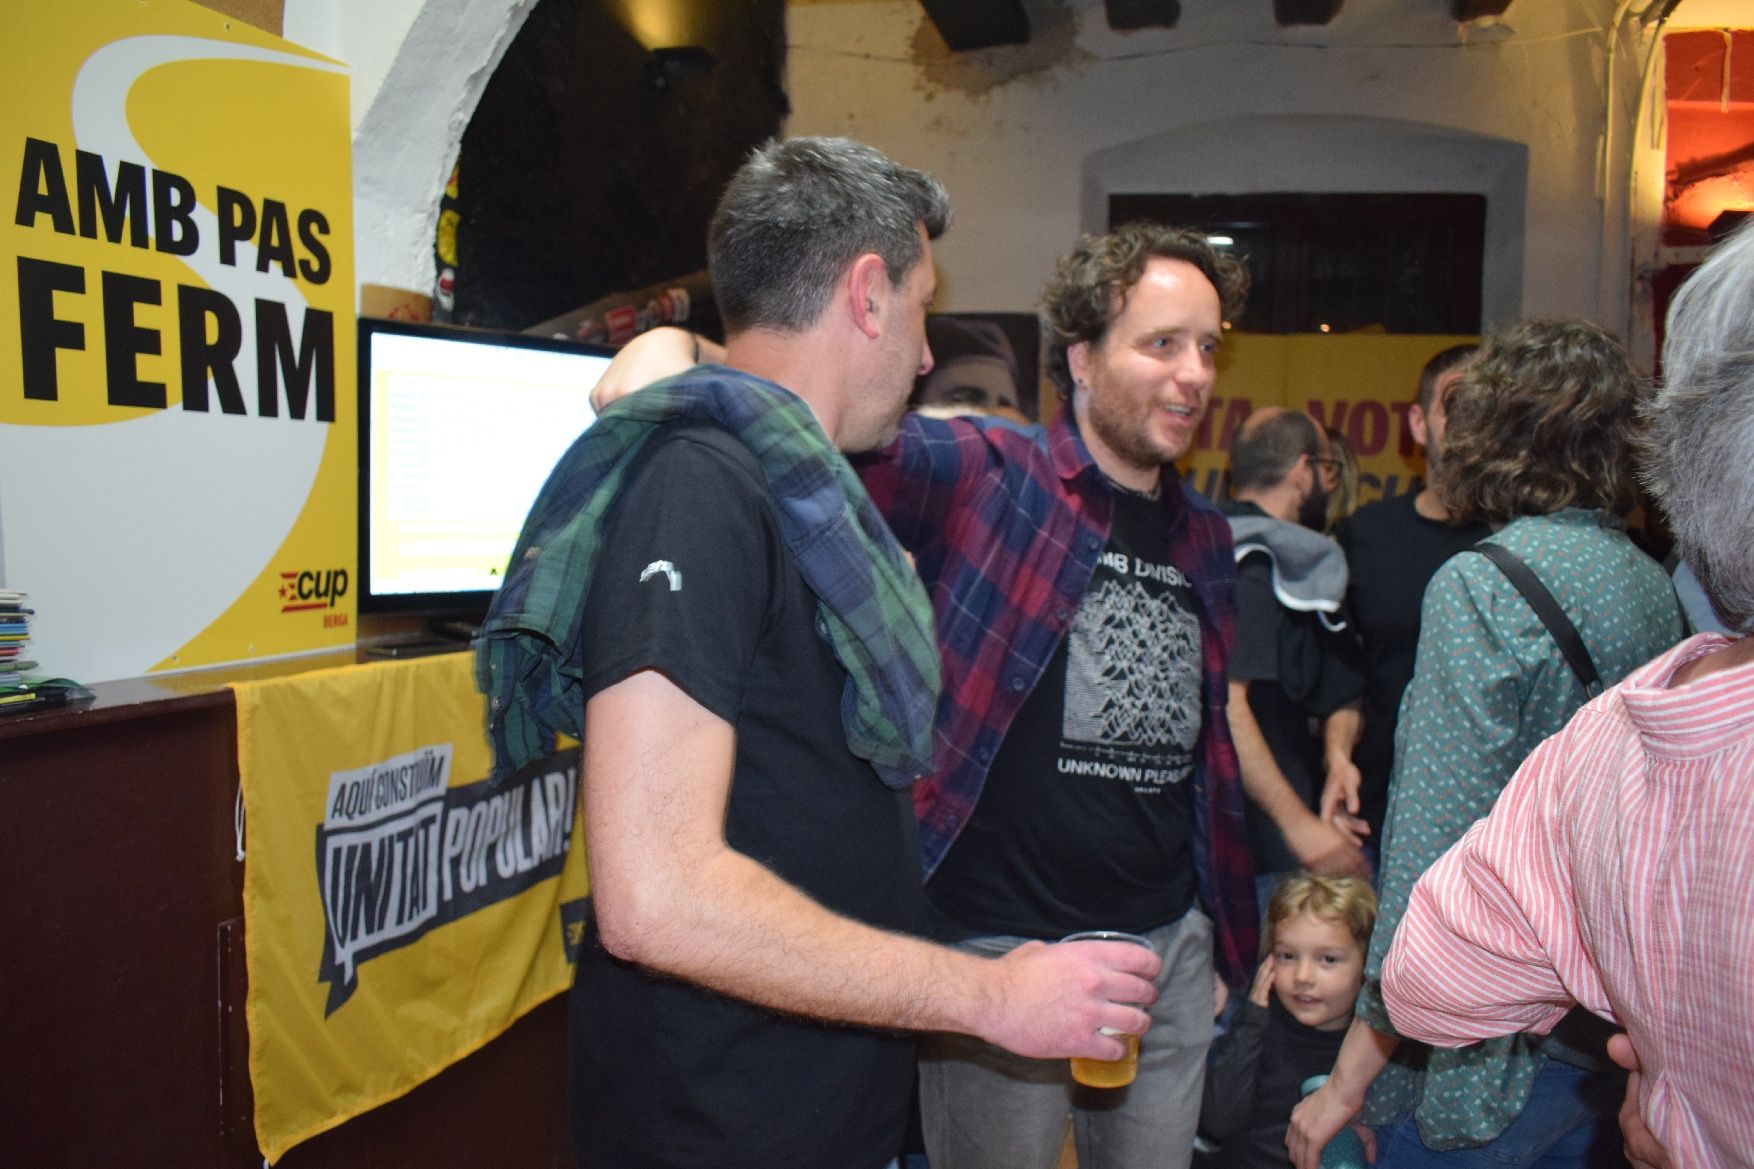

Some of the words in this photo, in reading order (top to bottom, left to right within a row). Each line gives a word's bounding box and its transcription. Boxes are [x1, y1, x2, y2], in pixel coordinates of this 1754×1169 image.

[15, 136, 200, 257] AMB
[216, 184, 332, 286] PAS
[16, 255, 336, 424] FERM
[297, 569, 349, 608] cup
[331, 767, 377, 820] AQUÍ
[1057, 757, 1142, 782] UNKNOWN
[330, 813, 438, 949] UNITAT
[441, 765, 577, 901] POPULAR!
